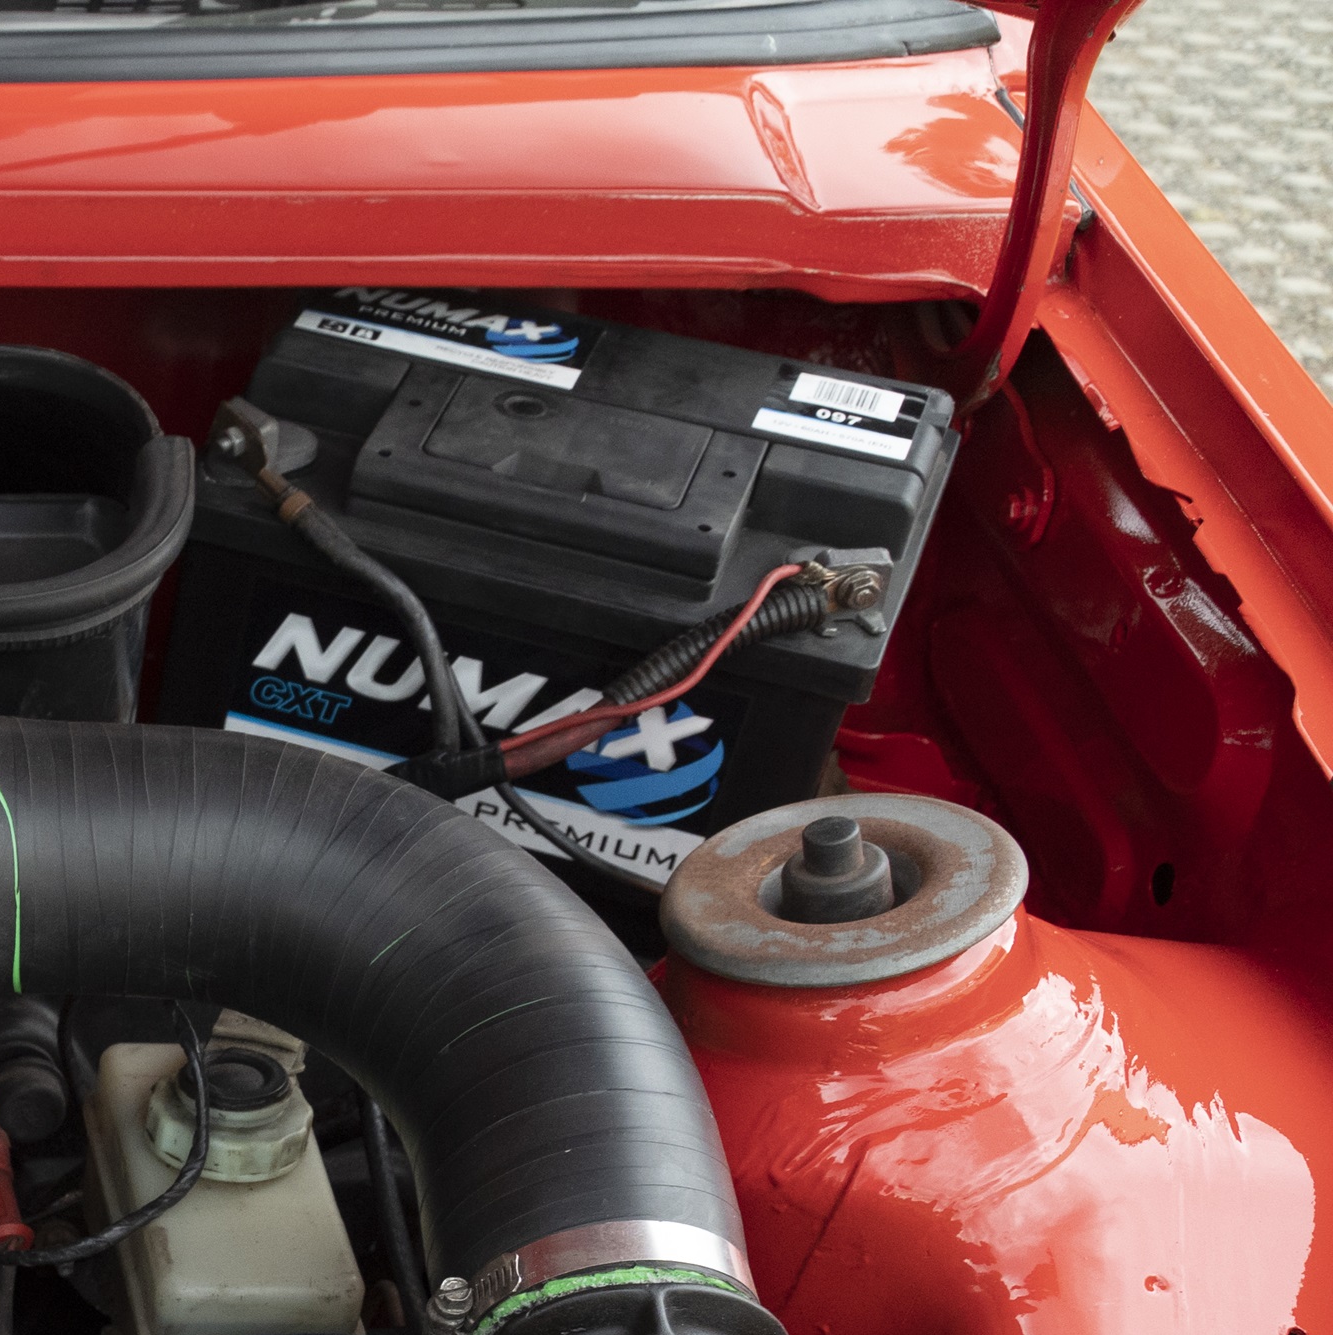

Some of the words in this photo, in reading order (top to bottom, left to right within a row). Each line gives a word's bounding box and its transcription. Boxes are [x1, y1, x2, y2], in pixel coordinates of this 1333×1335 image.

[335, 287, 562, 341] NUMAX
[359, 304, 467, 337] PREMIUM
[815, 408, 863, 426] 097
[249, 675, 352, 724] CXT
